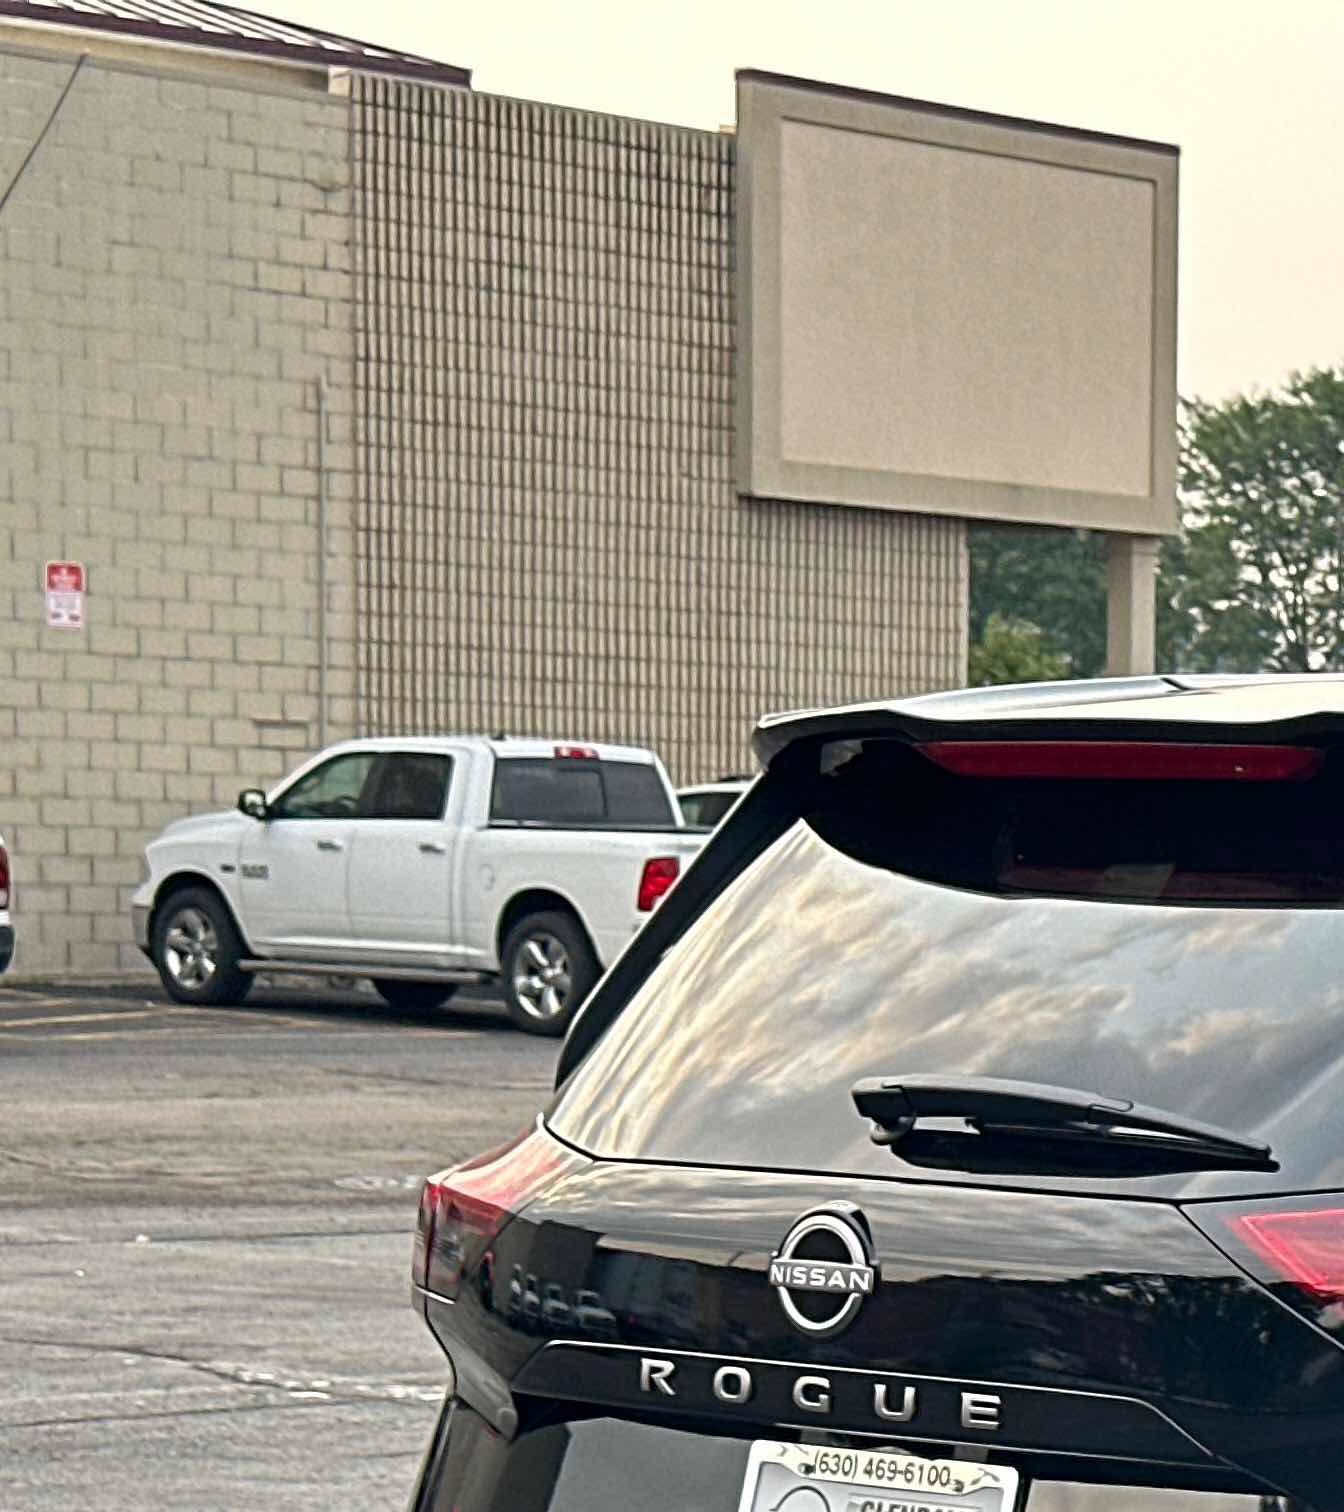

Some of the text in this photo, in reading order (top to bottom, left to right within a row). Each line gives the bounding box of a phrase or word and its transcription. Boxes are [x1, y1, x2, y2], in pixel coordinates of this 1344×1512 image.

[771, 1264, 871, 1293] NISSAN
[640, 1358, 1003, 1431] ROGUE
[815, 1450, 951, 1487] (630) 469-6100
